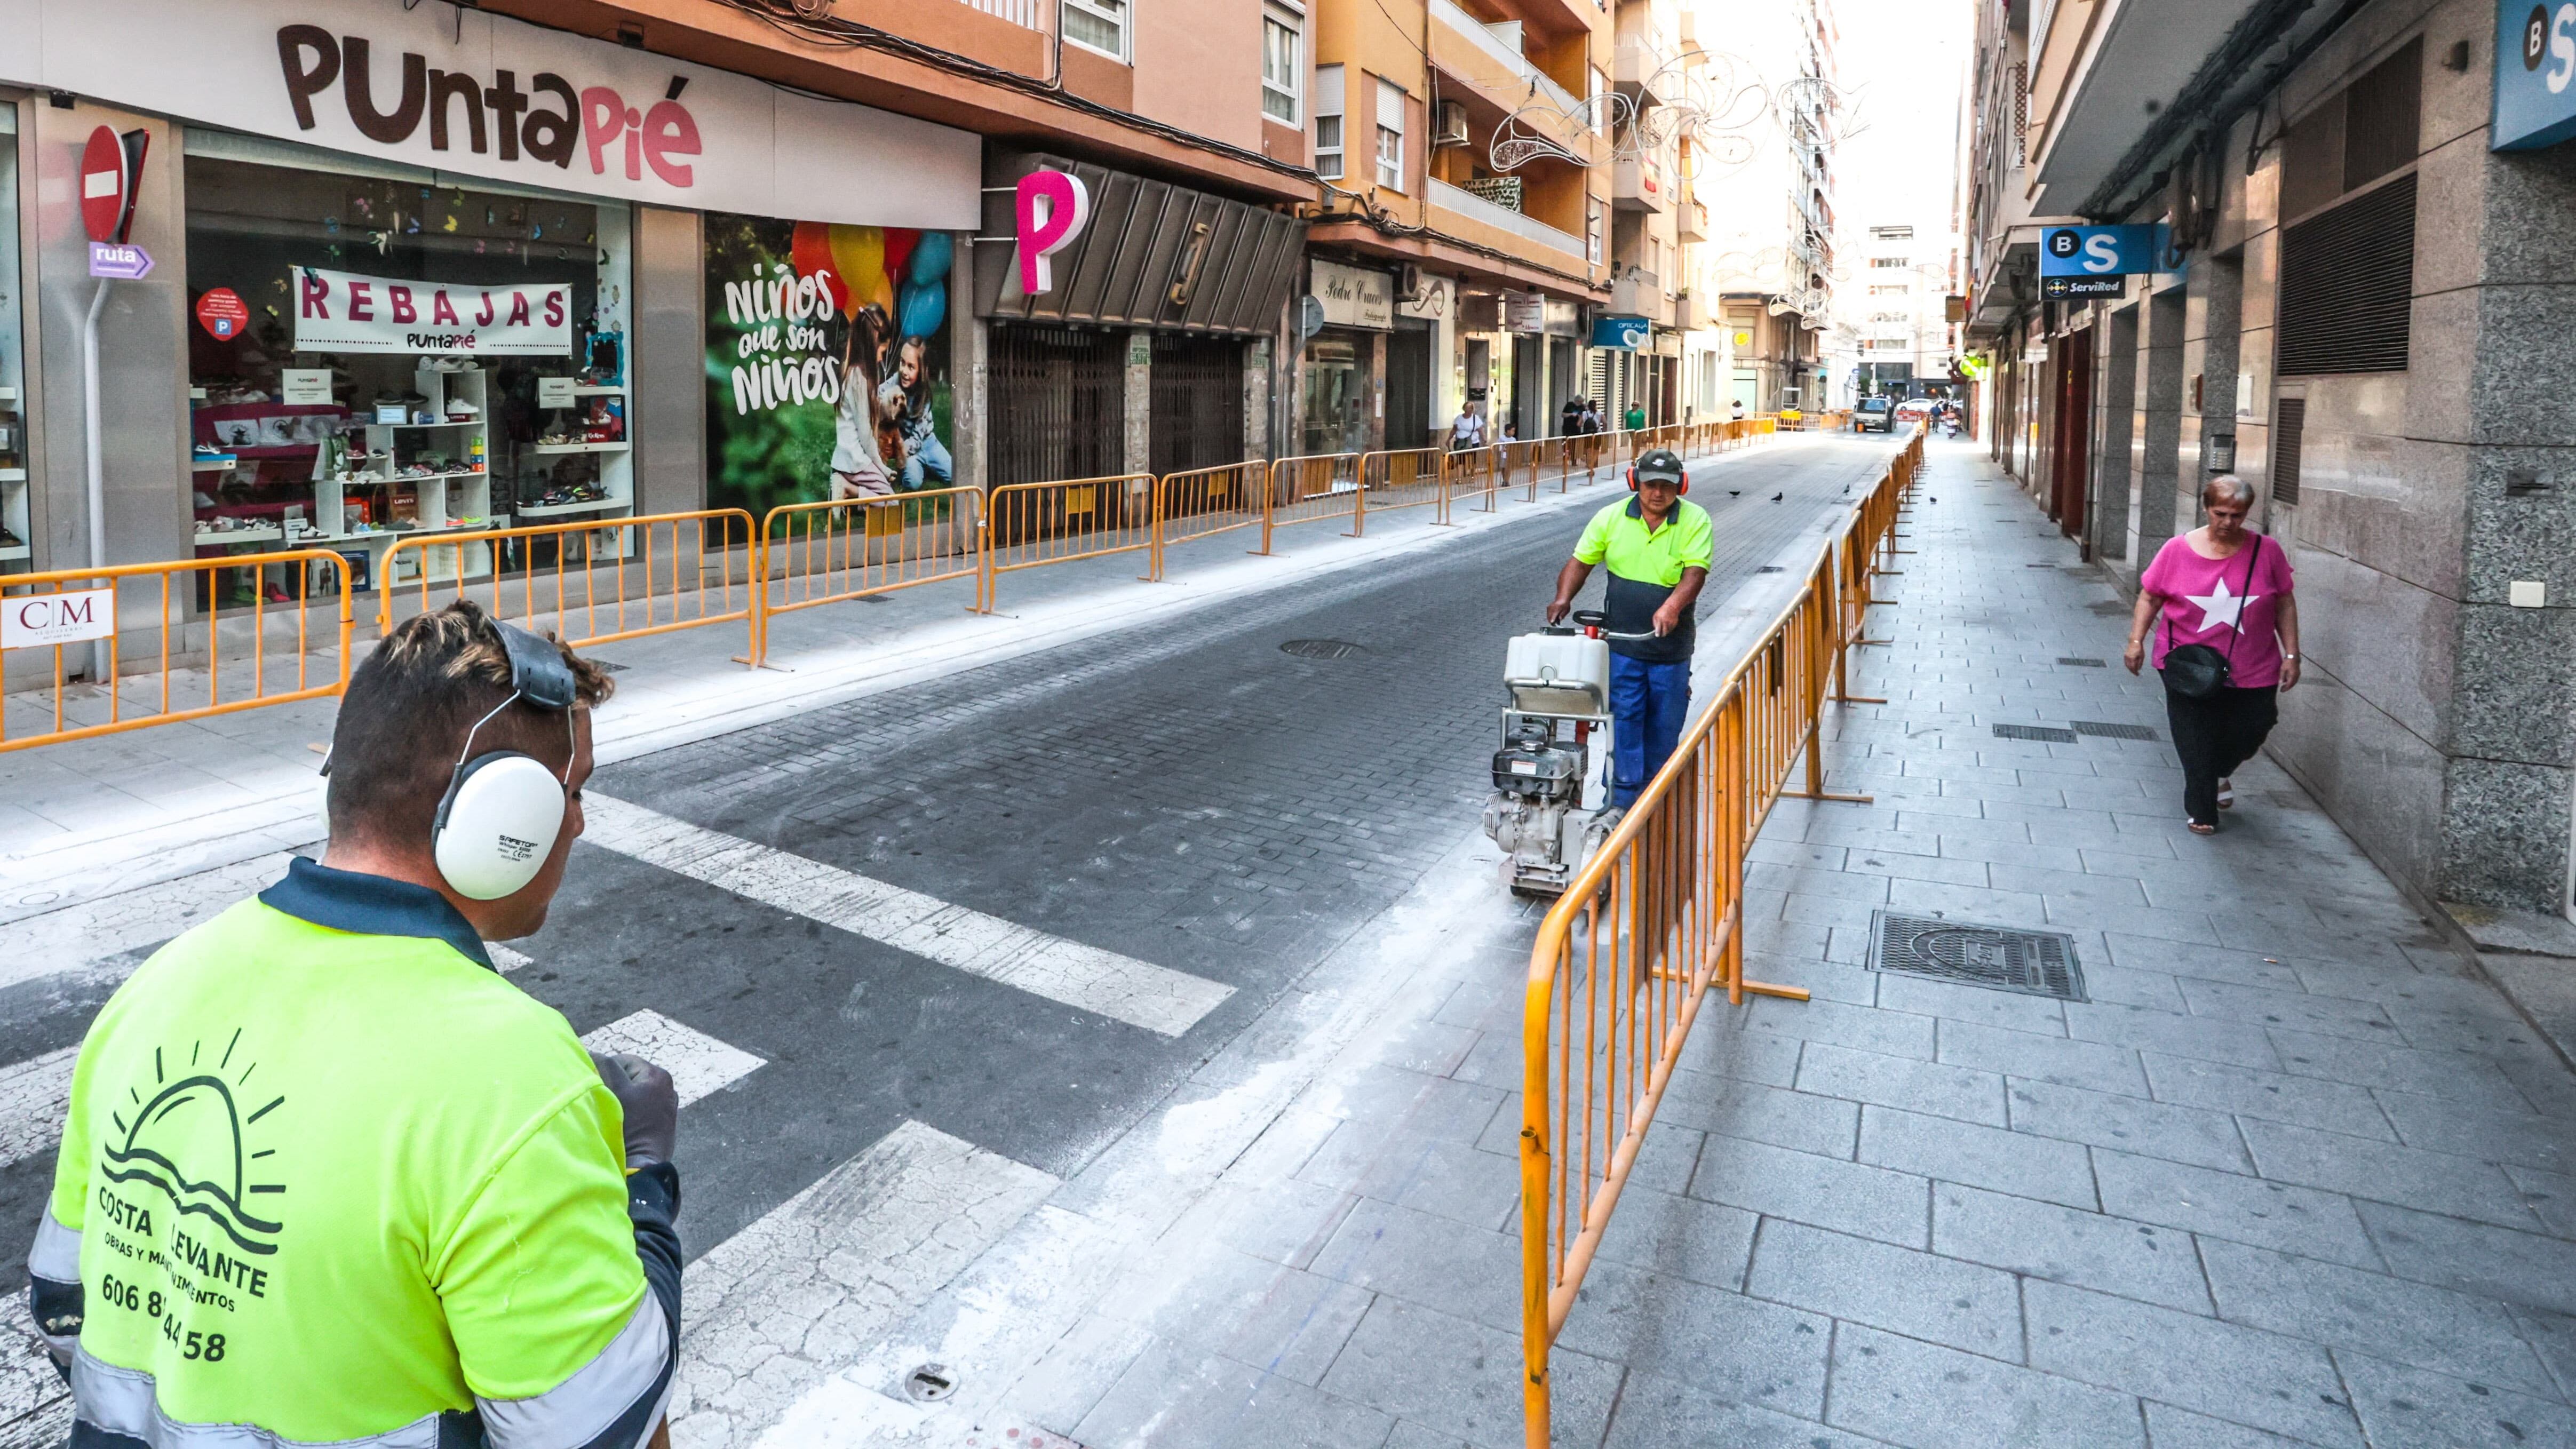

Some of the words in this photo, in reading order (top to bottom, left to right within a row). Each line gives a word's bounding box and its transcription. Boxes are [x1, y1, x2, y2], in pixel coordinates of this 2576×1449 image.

[1016, 171, 1088, 295] P
[2056, 236, 2072, 252] B
[96, 248, 136, 262] ruta
[1326, 275, 1351, 301] Pedro
[2070, 281, 2119, 292] ServiRed
[302, 276, 564, 328] REBAJAS
[219, 321, 228, 332] P
[738, 325, 781, 359] que
[785, 324, 826, 351] son
[100, 1186, 153, 1237] COSTA
[171, 1223, 268, 1299] LEVANTE
[105, 1232, 132, 1257] OBRAS
[137, 1247, 144, 1261] Y
[103, 1274, 139, 1311] 606
